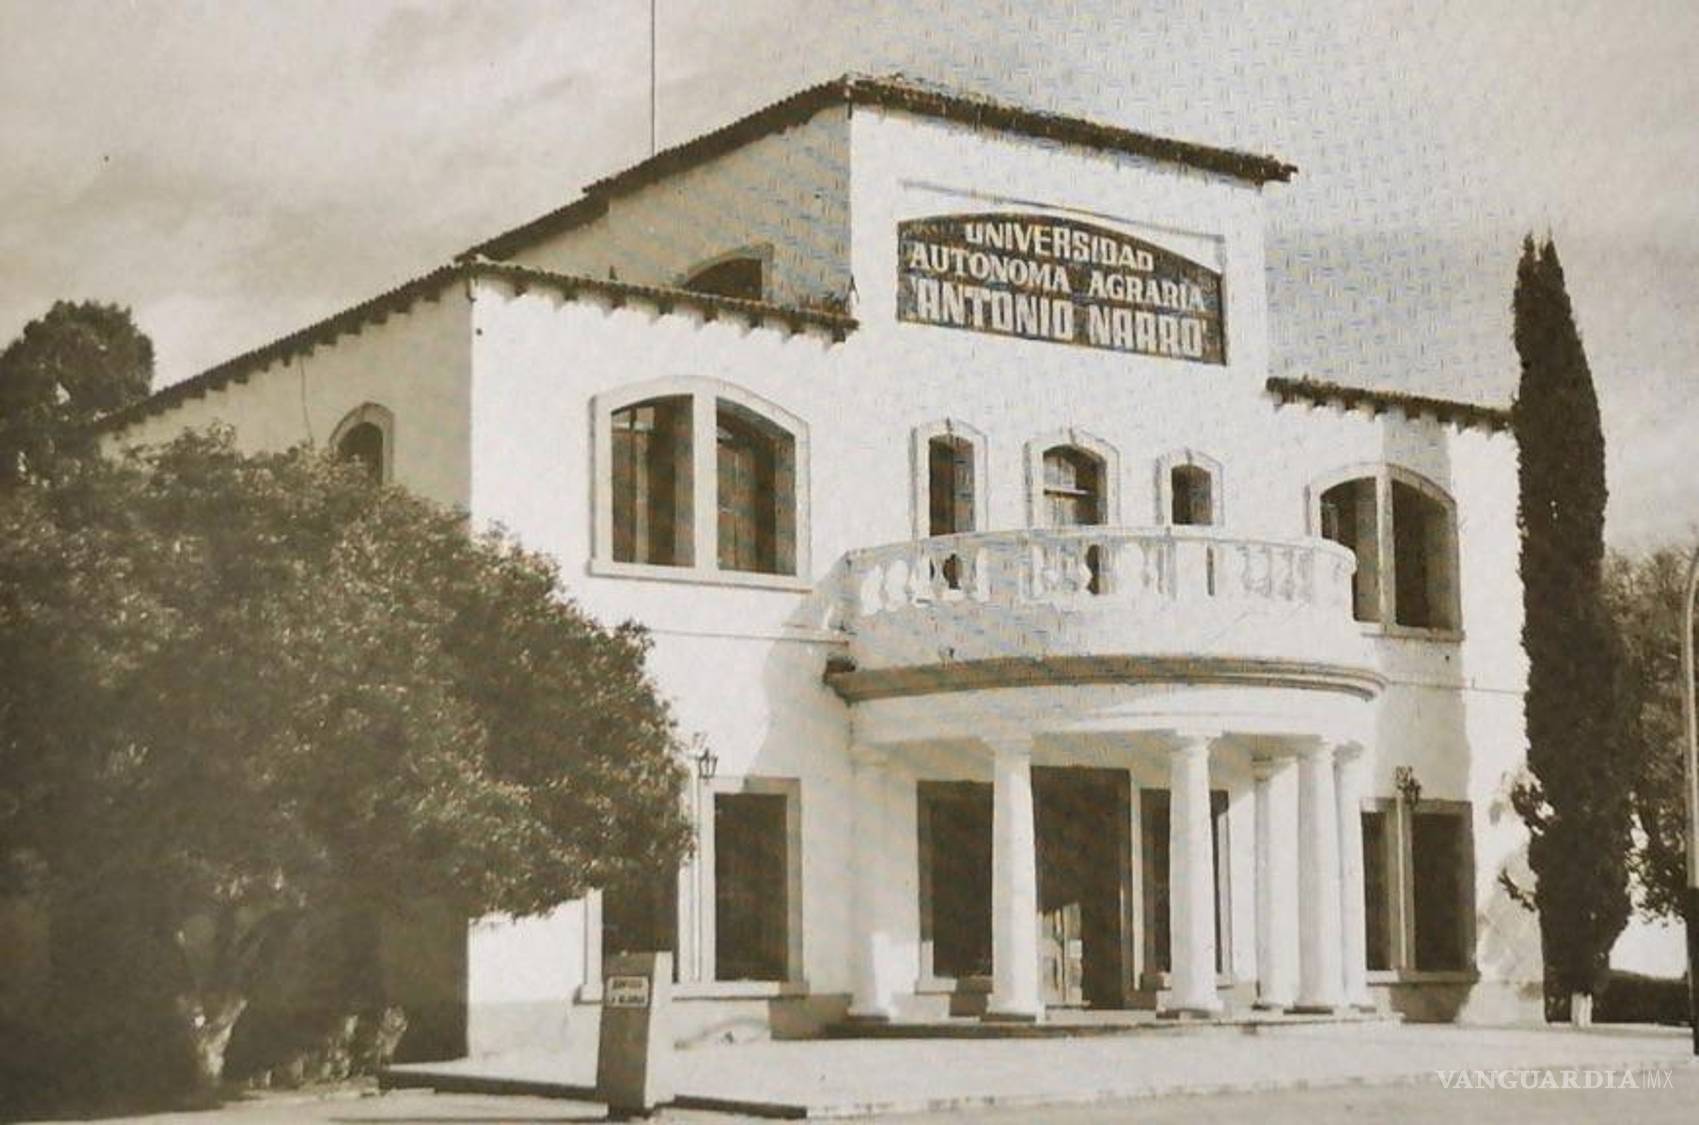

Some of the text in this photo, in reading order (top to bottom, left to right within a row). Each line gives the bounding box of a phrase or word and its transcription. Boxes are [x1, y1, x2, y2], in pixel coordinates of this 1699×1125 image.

[909, 241, 1206, 312] AUTONOMA AGRARIA
[965, 221, 1154, 272] UNIVERSIDAD
